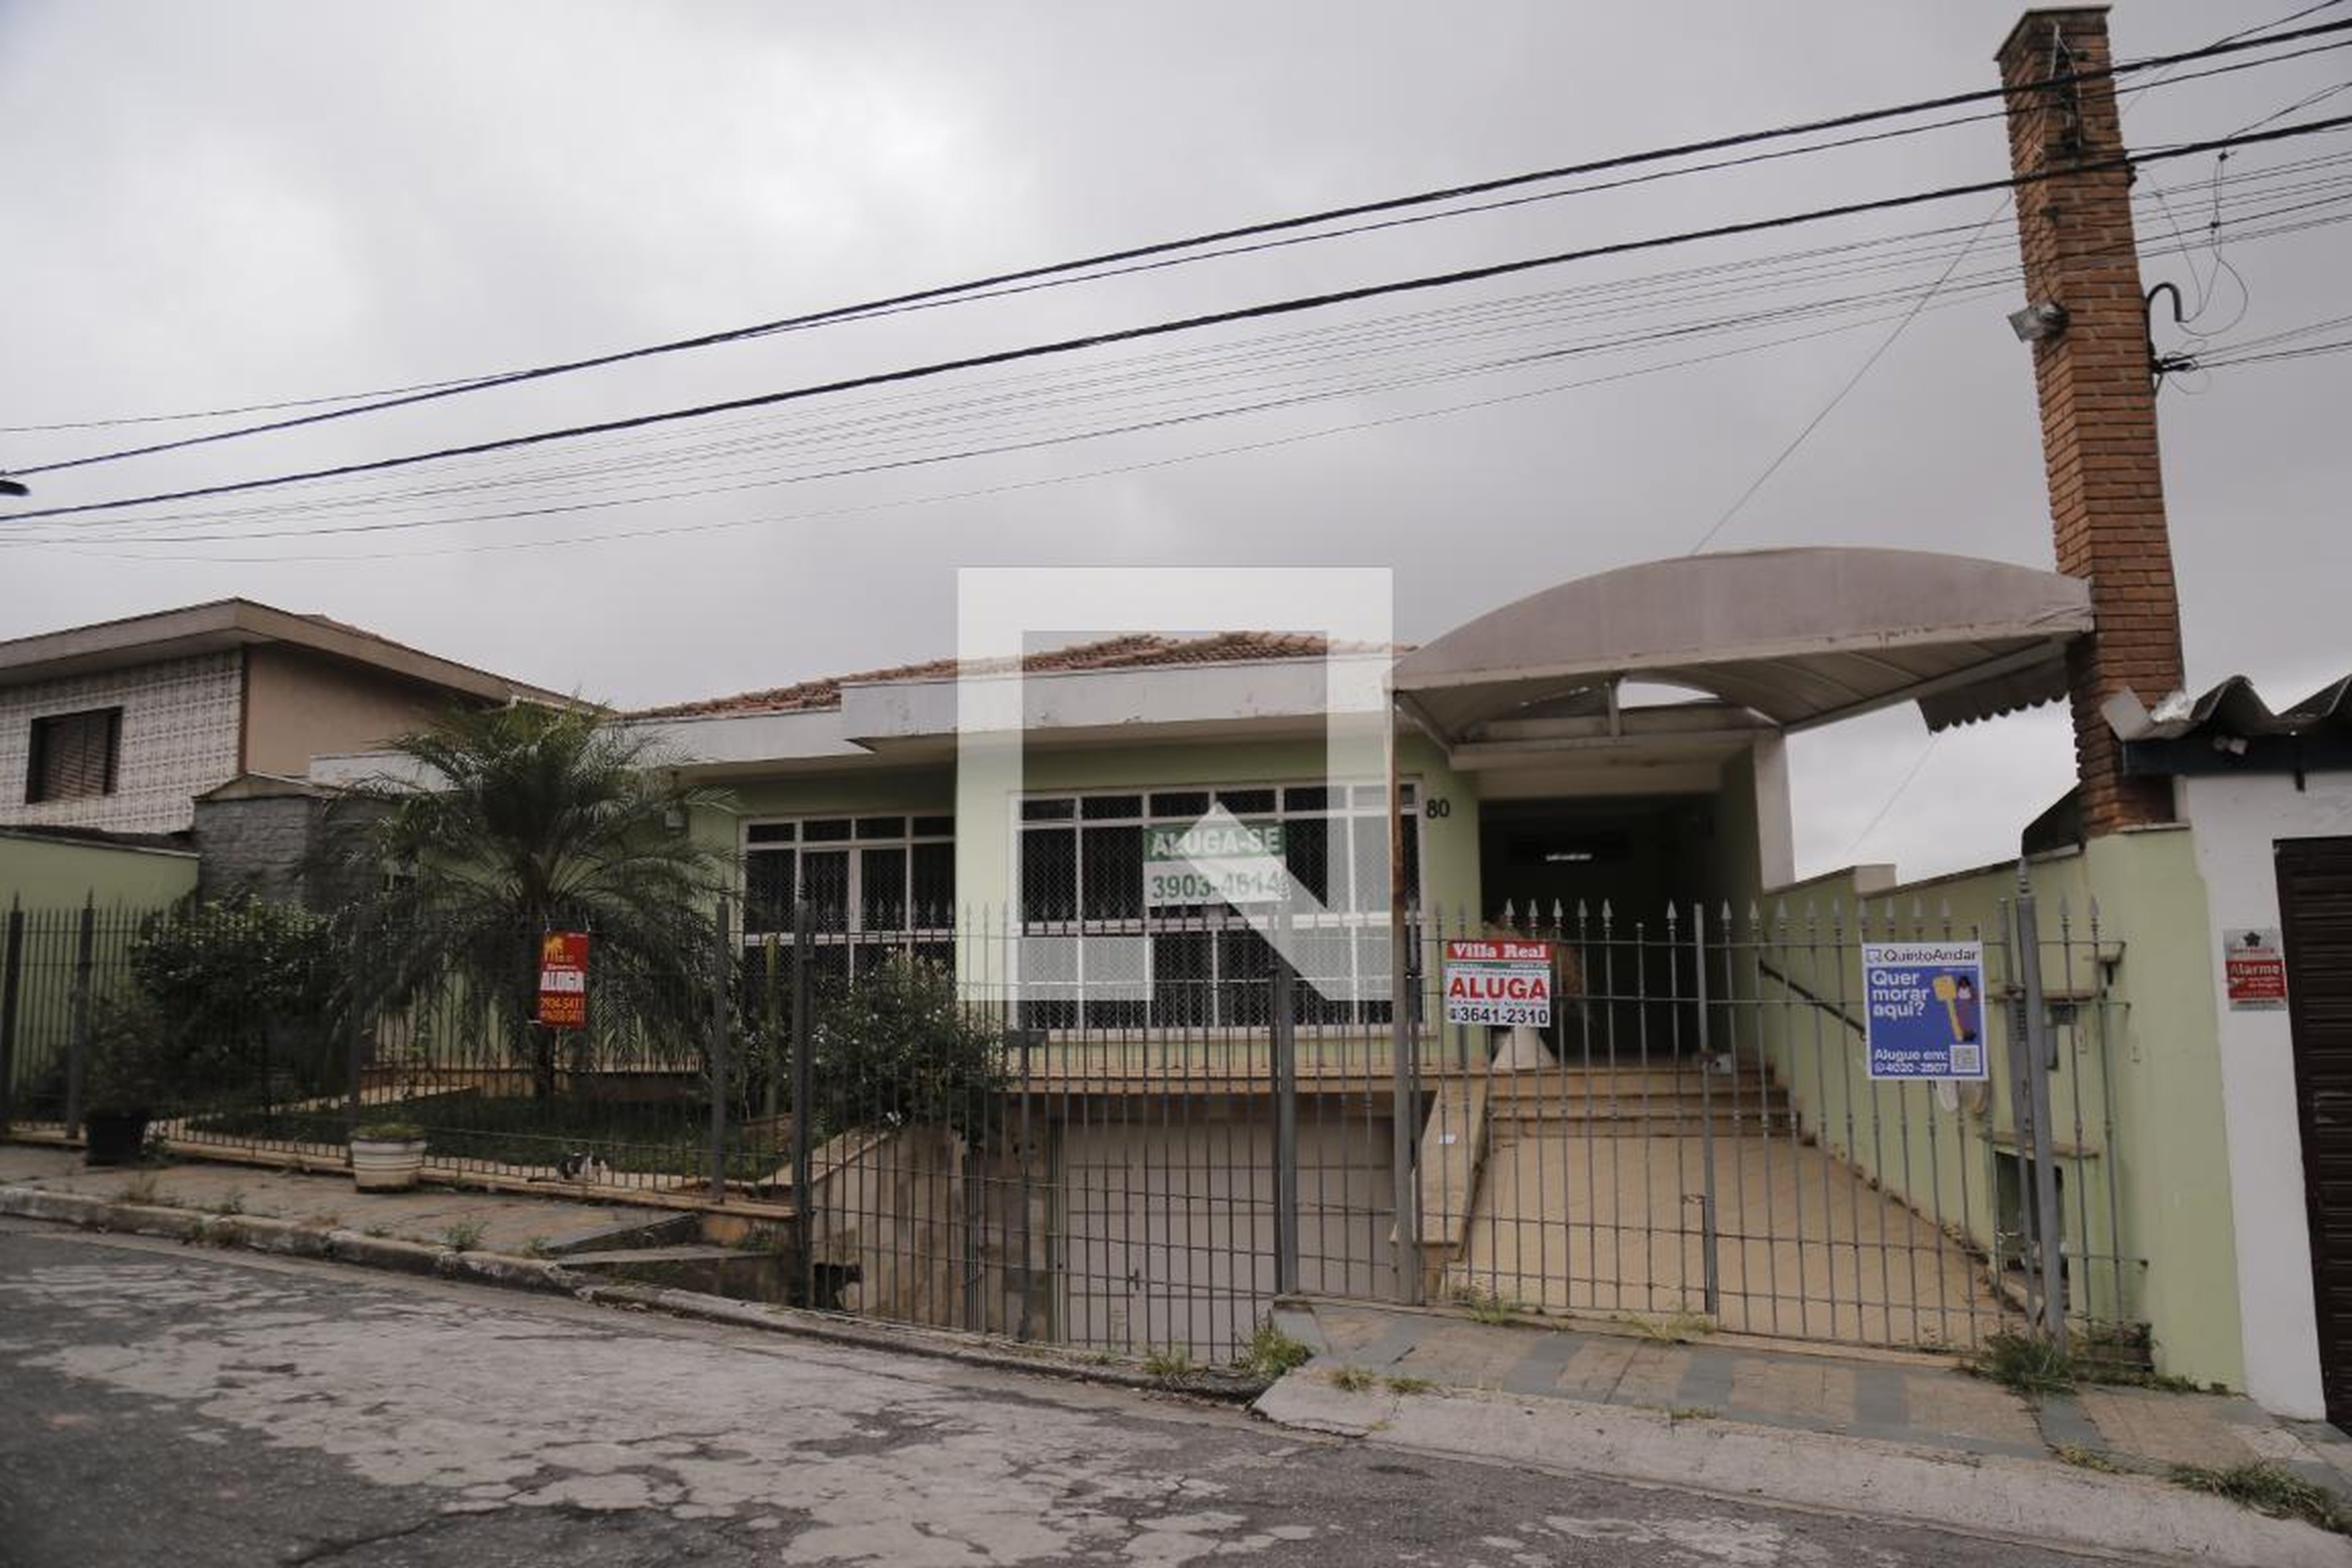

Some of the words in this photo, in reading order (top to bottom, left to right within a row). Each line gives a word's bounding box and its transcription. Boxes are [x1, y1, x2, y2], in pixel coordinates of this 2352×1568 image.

[1427, 797, 1450, 818] 80
[1152, 827, 1281, 856] ALUGA-SE
[1452, 943, 1497, 958] Villa
[1504, 943, 1547, 959] Real
[1884, 949, 1977, 962] QuintoAndar
[1871, 969, 1920, 986] Quer
[1449, 977, 1548, 1000] ALUGA
[1872, 988, 1929, 1001] morar
[1460, 1007, 1548, 1023] 3641-2310
[1872, 1001, 1925, 1020] aqui?
[1874, 1049, 1921, 1061] Alugue
